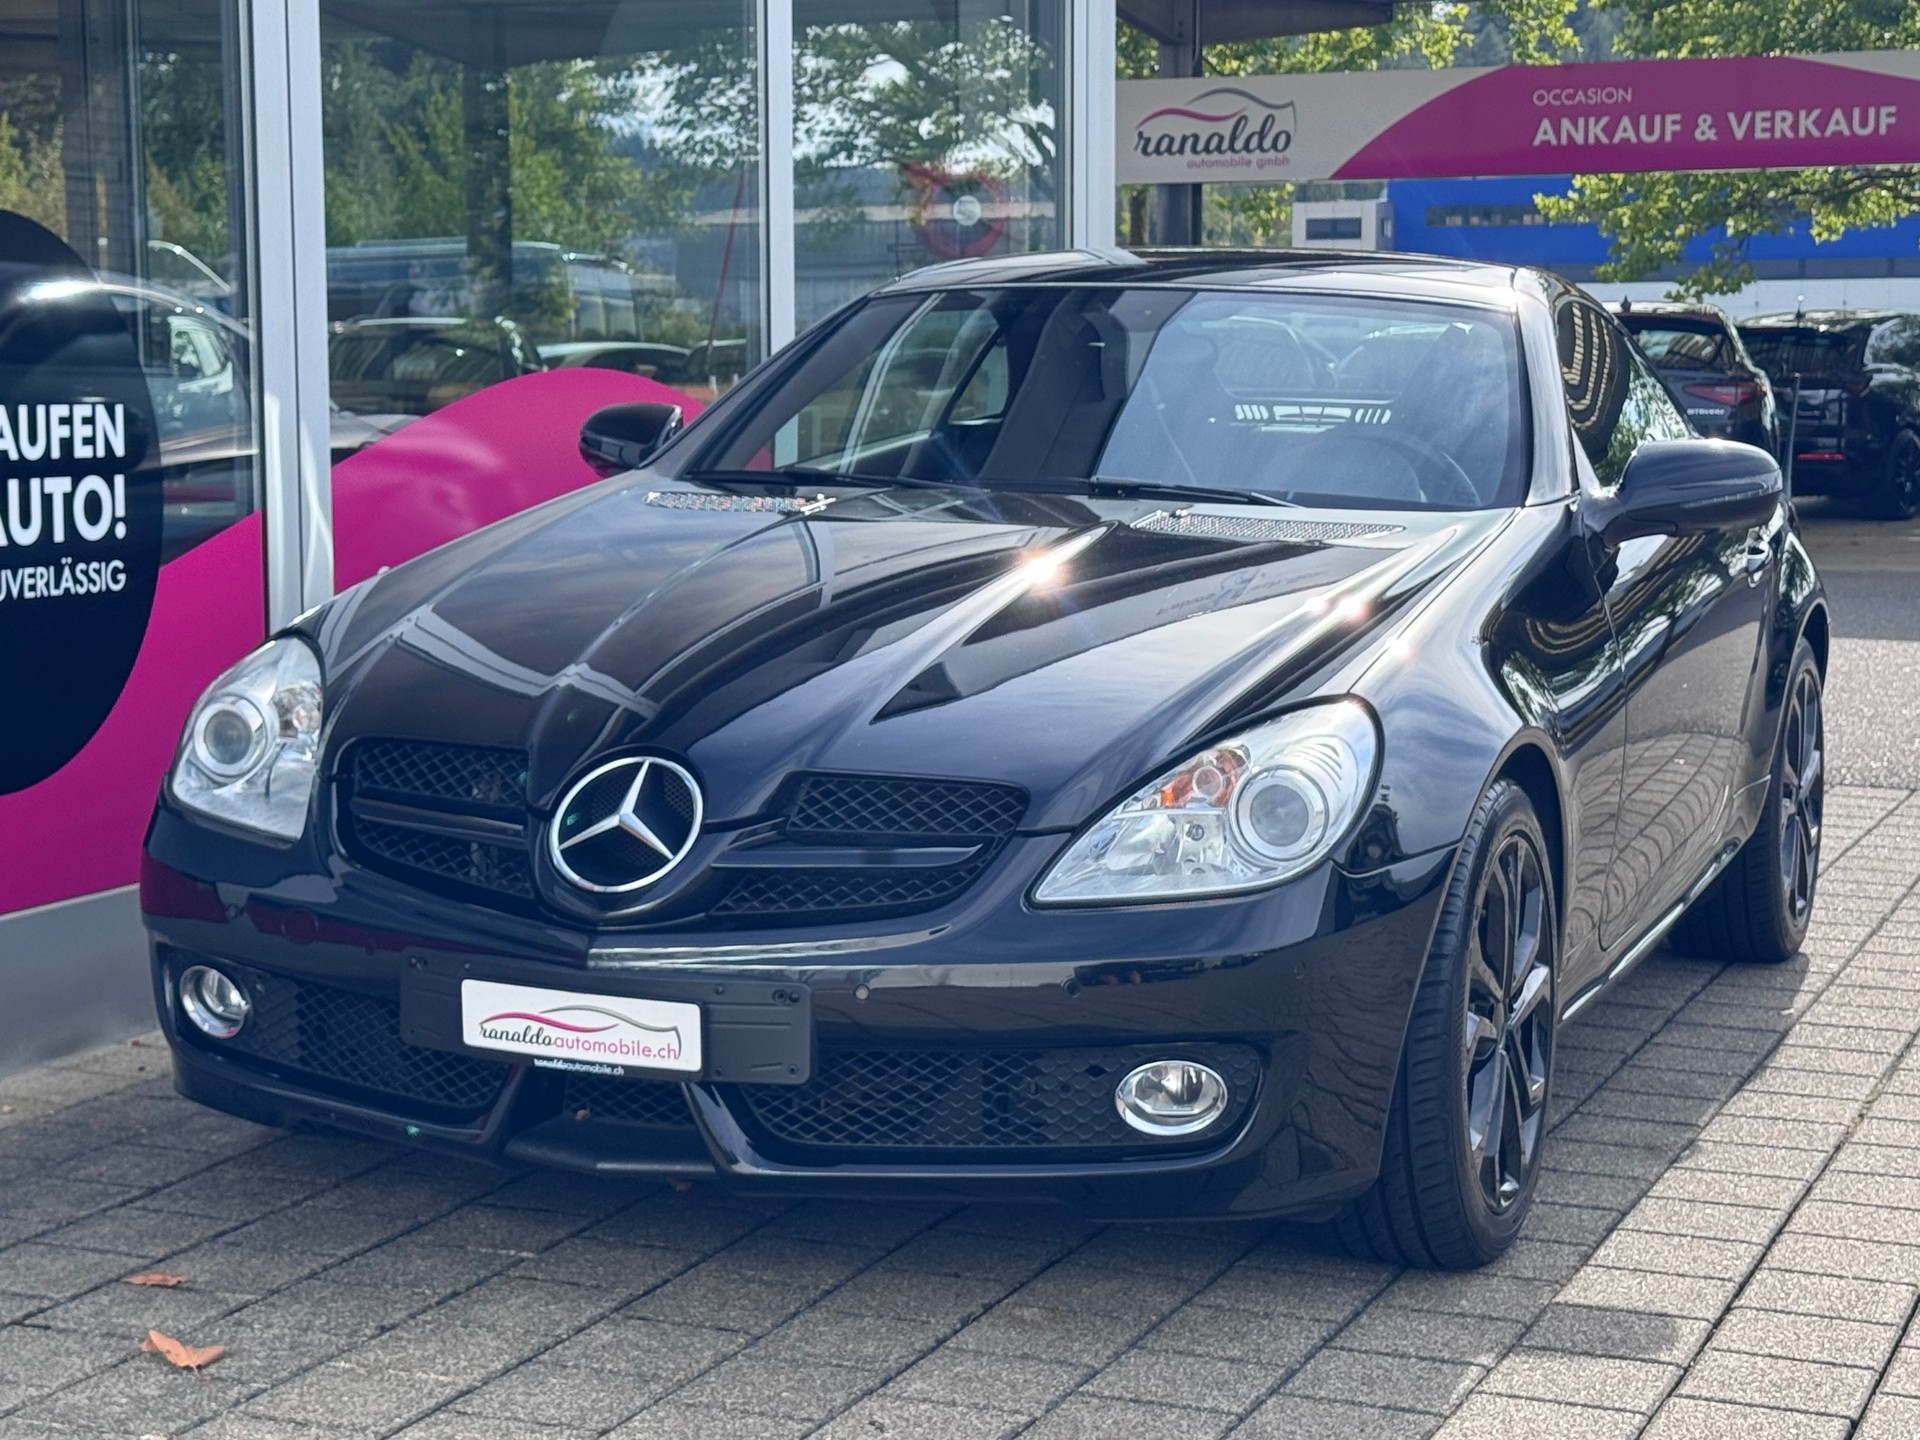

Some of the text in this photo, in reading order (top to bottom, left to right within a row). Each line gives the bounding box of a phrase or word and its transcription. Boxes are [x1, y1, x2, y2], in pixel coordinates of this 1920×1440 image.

[1533, 87, 1632, 106] OCCASION
[1134, 113, 1291, 157] ranaldo
[1533, 106, 1897, 146] ANKAUF & VERKAUF
[1187, 155, 1290, 169] automobile gmbh
